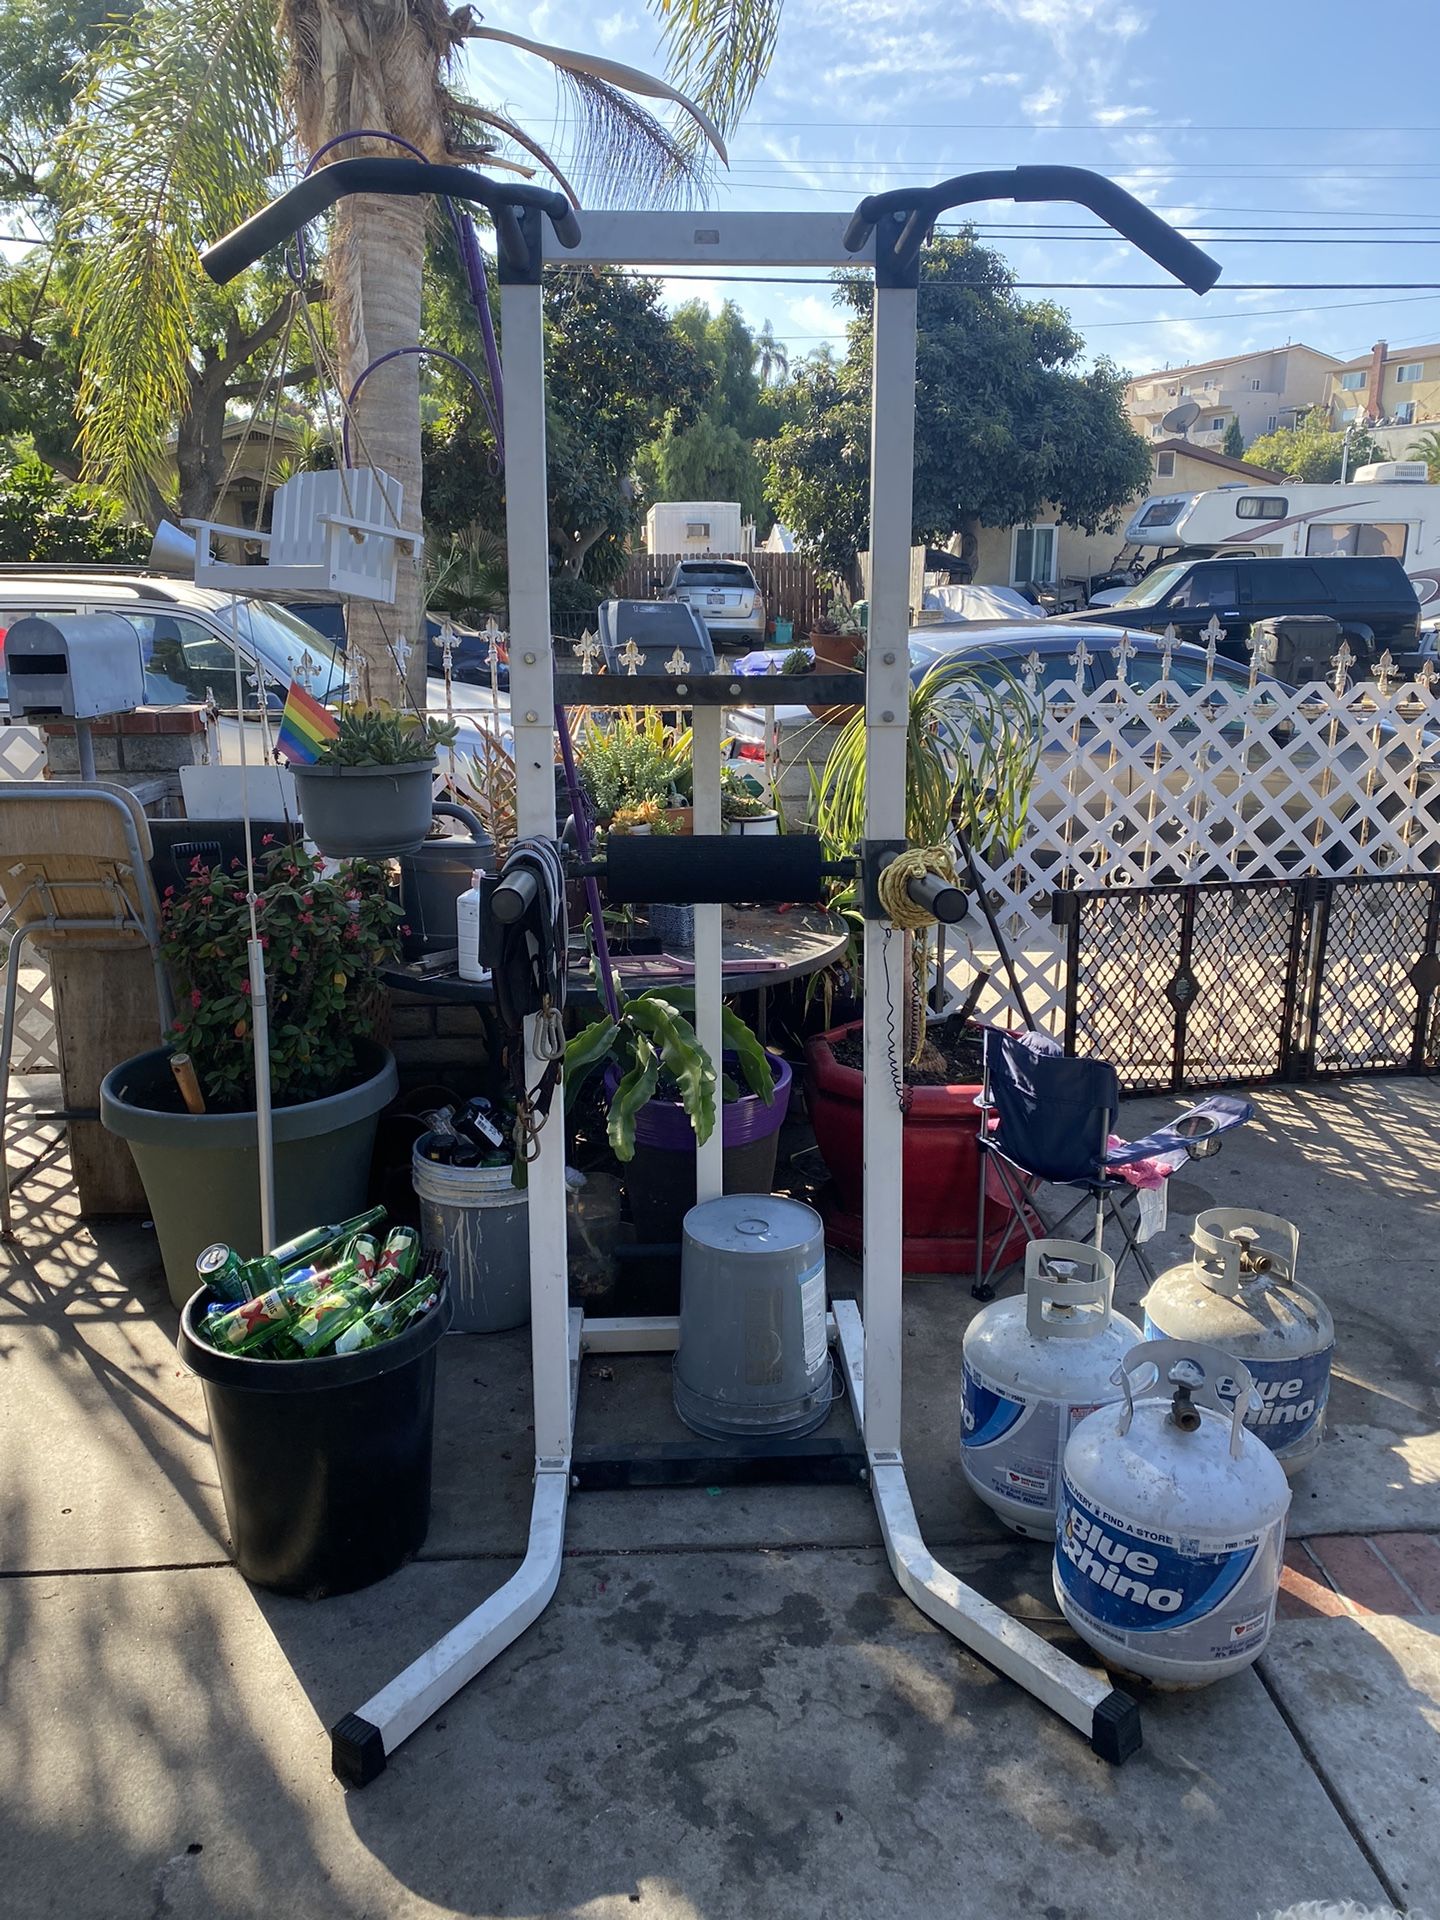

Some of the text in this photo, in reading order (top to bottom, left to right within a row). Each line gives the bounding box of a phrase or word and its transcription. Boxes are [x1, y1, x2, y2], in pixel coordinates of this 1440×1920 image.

[1222, 1397, 1316, 1425] hino
[1066, 1478, 1174, 1545] DELIVERY FIND A STORE
[1070, 1507, 1159, 1576] Blue
[1062, 1536, 1183, 1612] Rhino
